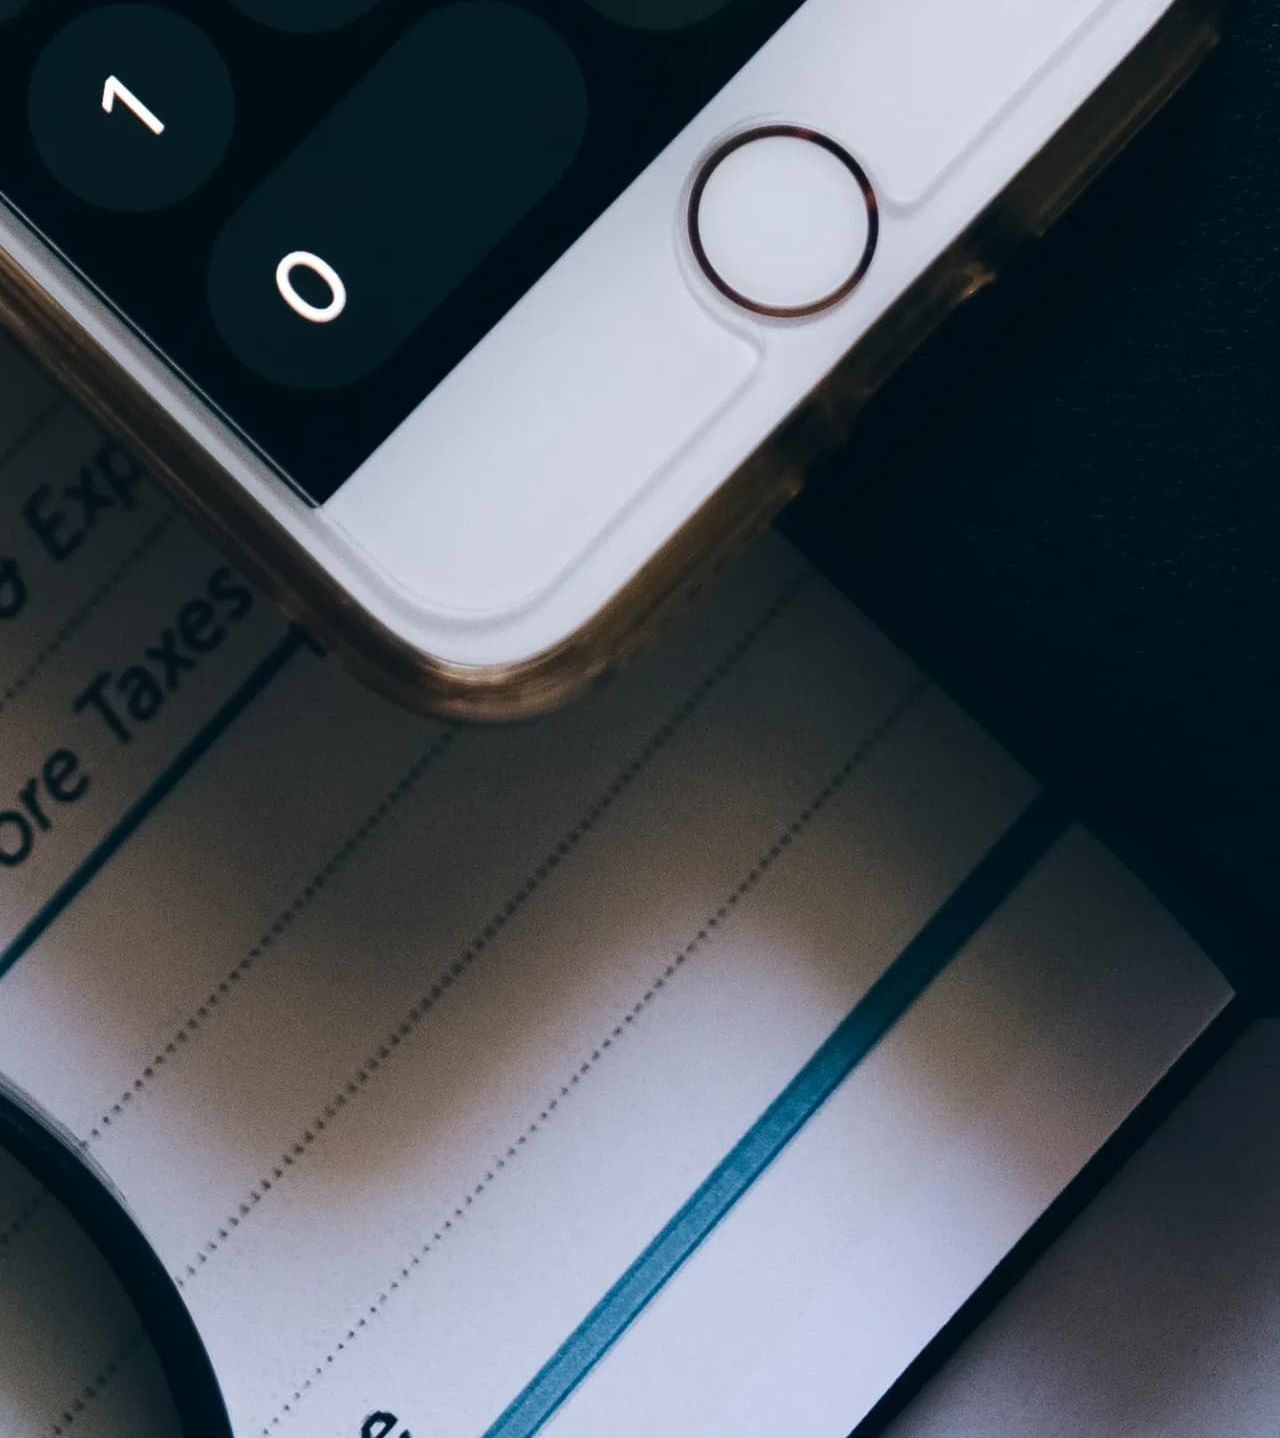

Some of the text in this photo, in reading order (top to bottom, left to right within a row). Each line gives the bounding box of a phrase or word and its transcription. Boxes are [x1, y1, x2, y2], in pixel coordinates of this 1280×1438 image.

[102, 76, 166, 136] 1
[276, 251, 346, 322] 0
[20, 436, 144, 562] Exp
[72, 565, 254, 743] Taxes
